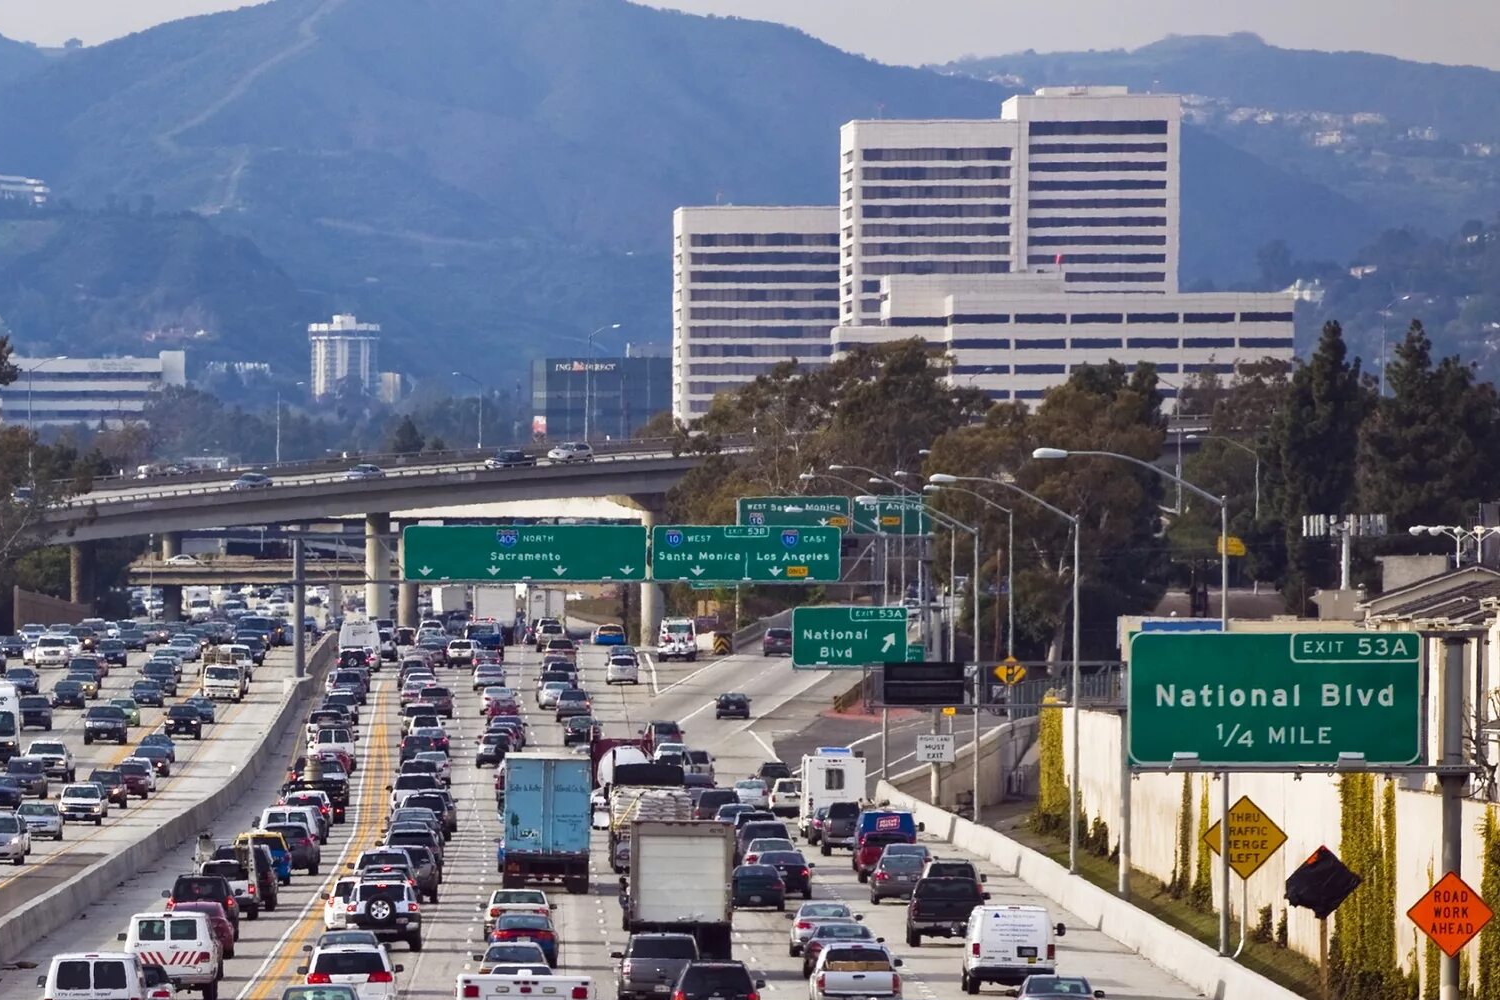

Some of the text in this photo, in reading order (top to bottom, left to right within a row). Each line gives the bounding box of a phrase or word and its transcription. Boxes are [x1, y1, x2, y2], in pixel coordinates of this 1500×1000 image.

[555, 363, 571, 371] ING
[499, 534, 517, 543] 405
[669, 535, 679, 543] 10
[786, 535, 795, 544] 10
[490, 551, 561, 561] Sacramento
[658, 551, 741, 561] Santa Monica
[756, 552, 830, 563] Los Angeles
[788, 567, 807, 575] ONLY
[855, 608, 903, 617] EXIT 53A
[803, 628, 868, 640] National
[1303, 638, 1409, 656] EXIT 53A
[820, 647, 852, 658] Blvd
[1156, 683, 1395, 708] National Blvd
[1216, 723, 1332, 746] 1/4 MILE
[1230, 812, 1260, 822] THRU
[1228, 826, 1268, 836] RAFFIC
[1230, 853, 1260, 863] LEFT
[1434, 890, 1468, 903] ROAD
[1433, 906, 1469, 919] WORK
[1430, 922, 1473, 935] AHEAD
